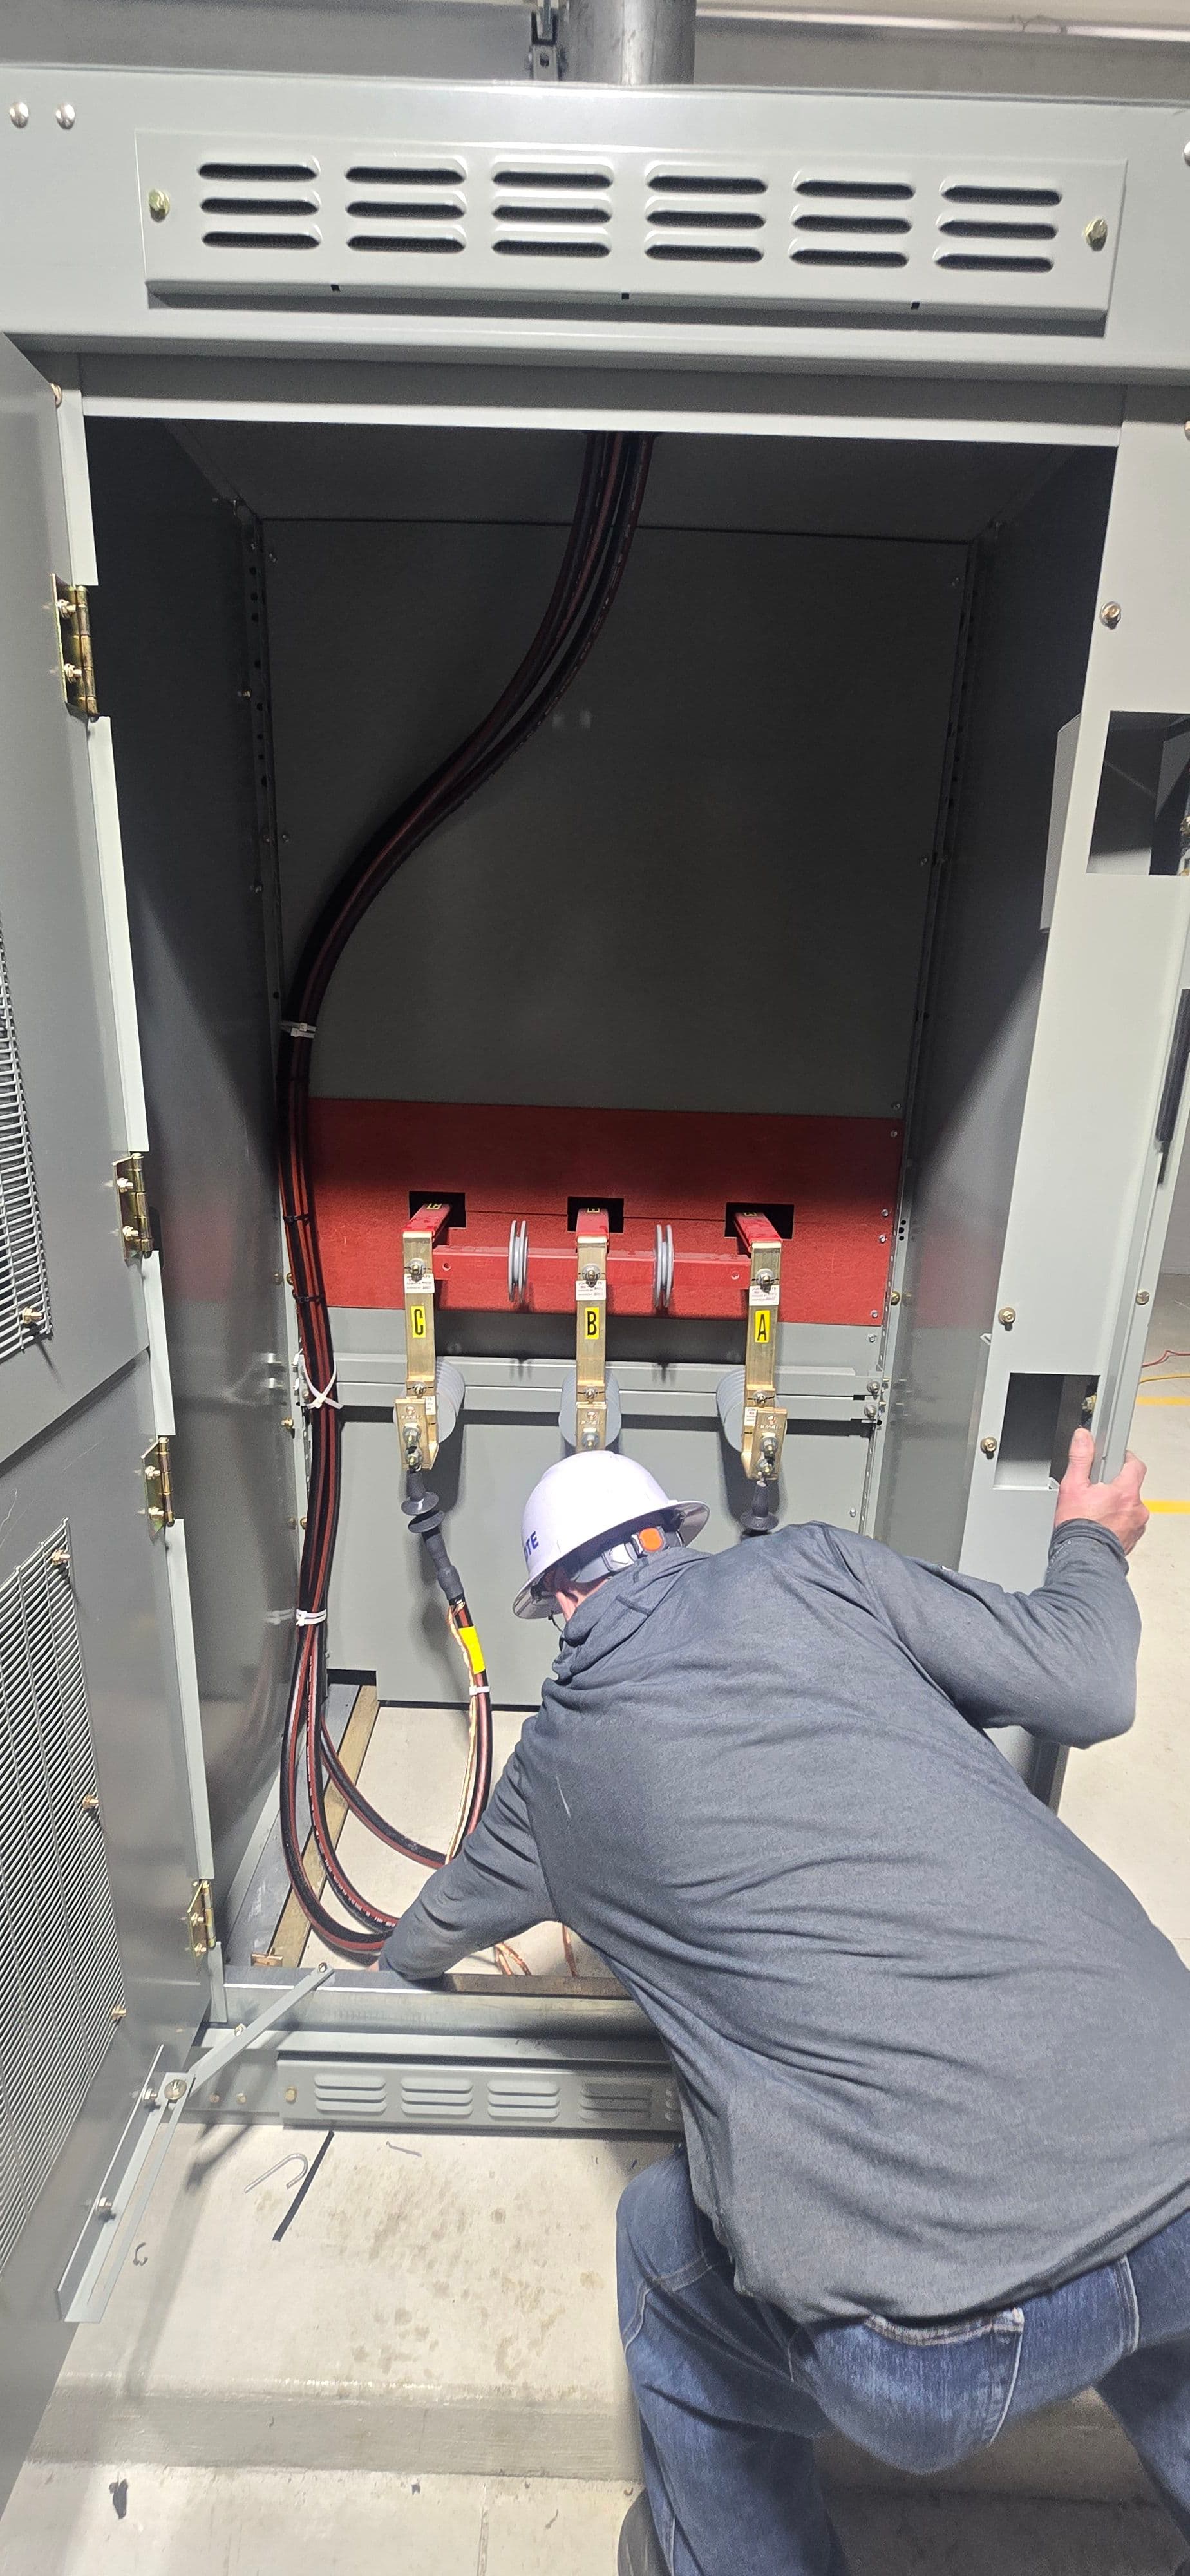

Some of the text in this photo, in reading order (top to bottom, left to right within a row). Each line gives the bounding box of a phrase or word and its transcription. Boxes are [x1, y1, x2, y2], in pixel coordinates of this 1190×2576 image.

[414, 1308, 424, 1335] C
[587, 1311, 597, 1335] B
[757, 1314, 767, 1341] A
